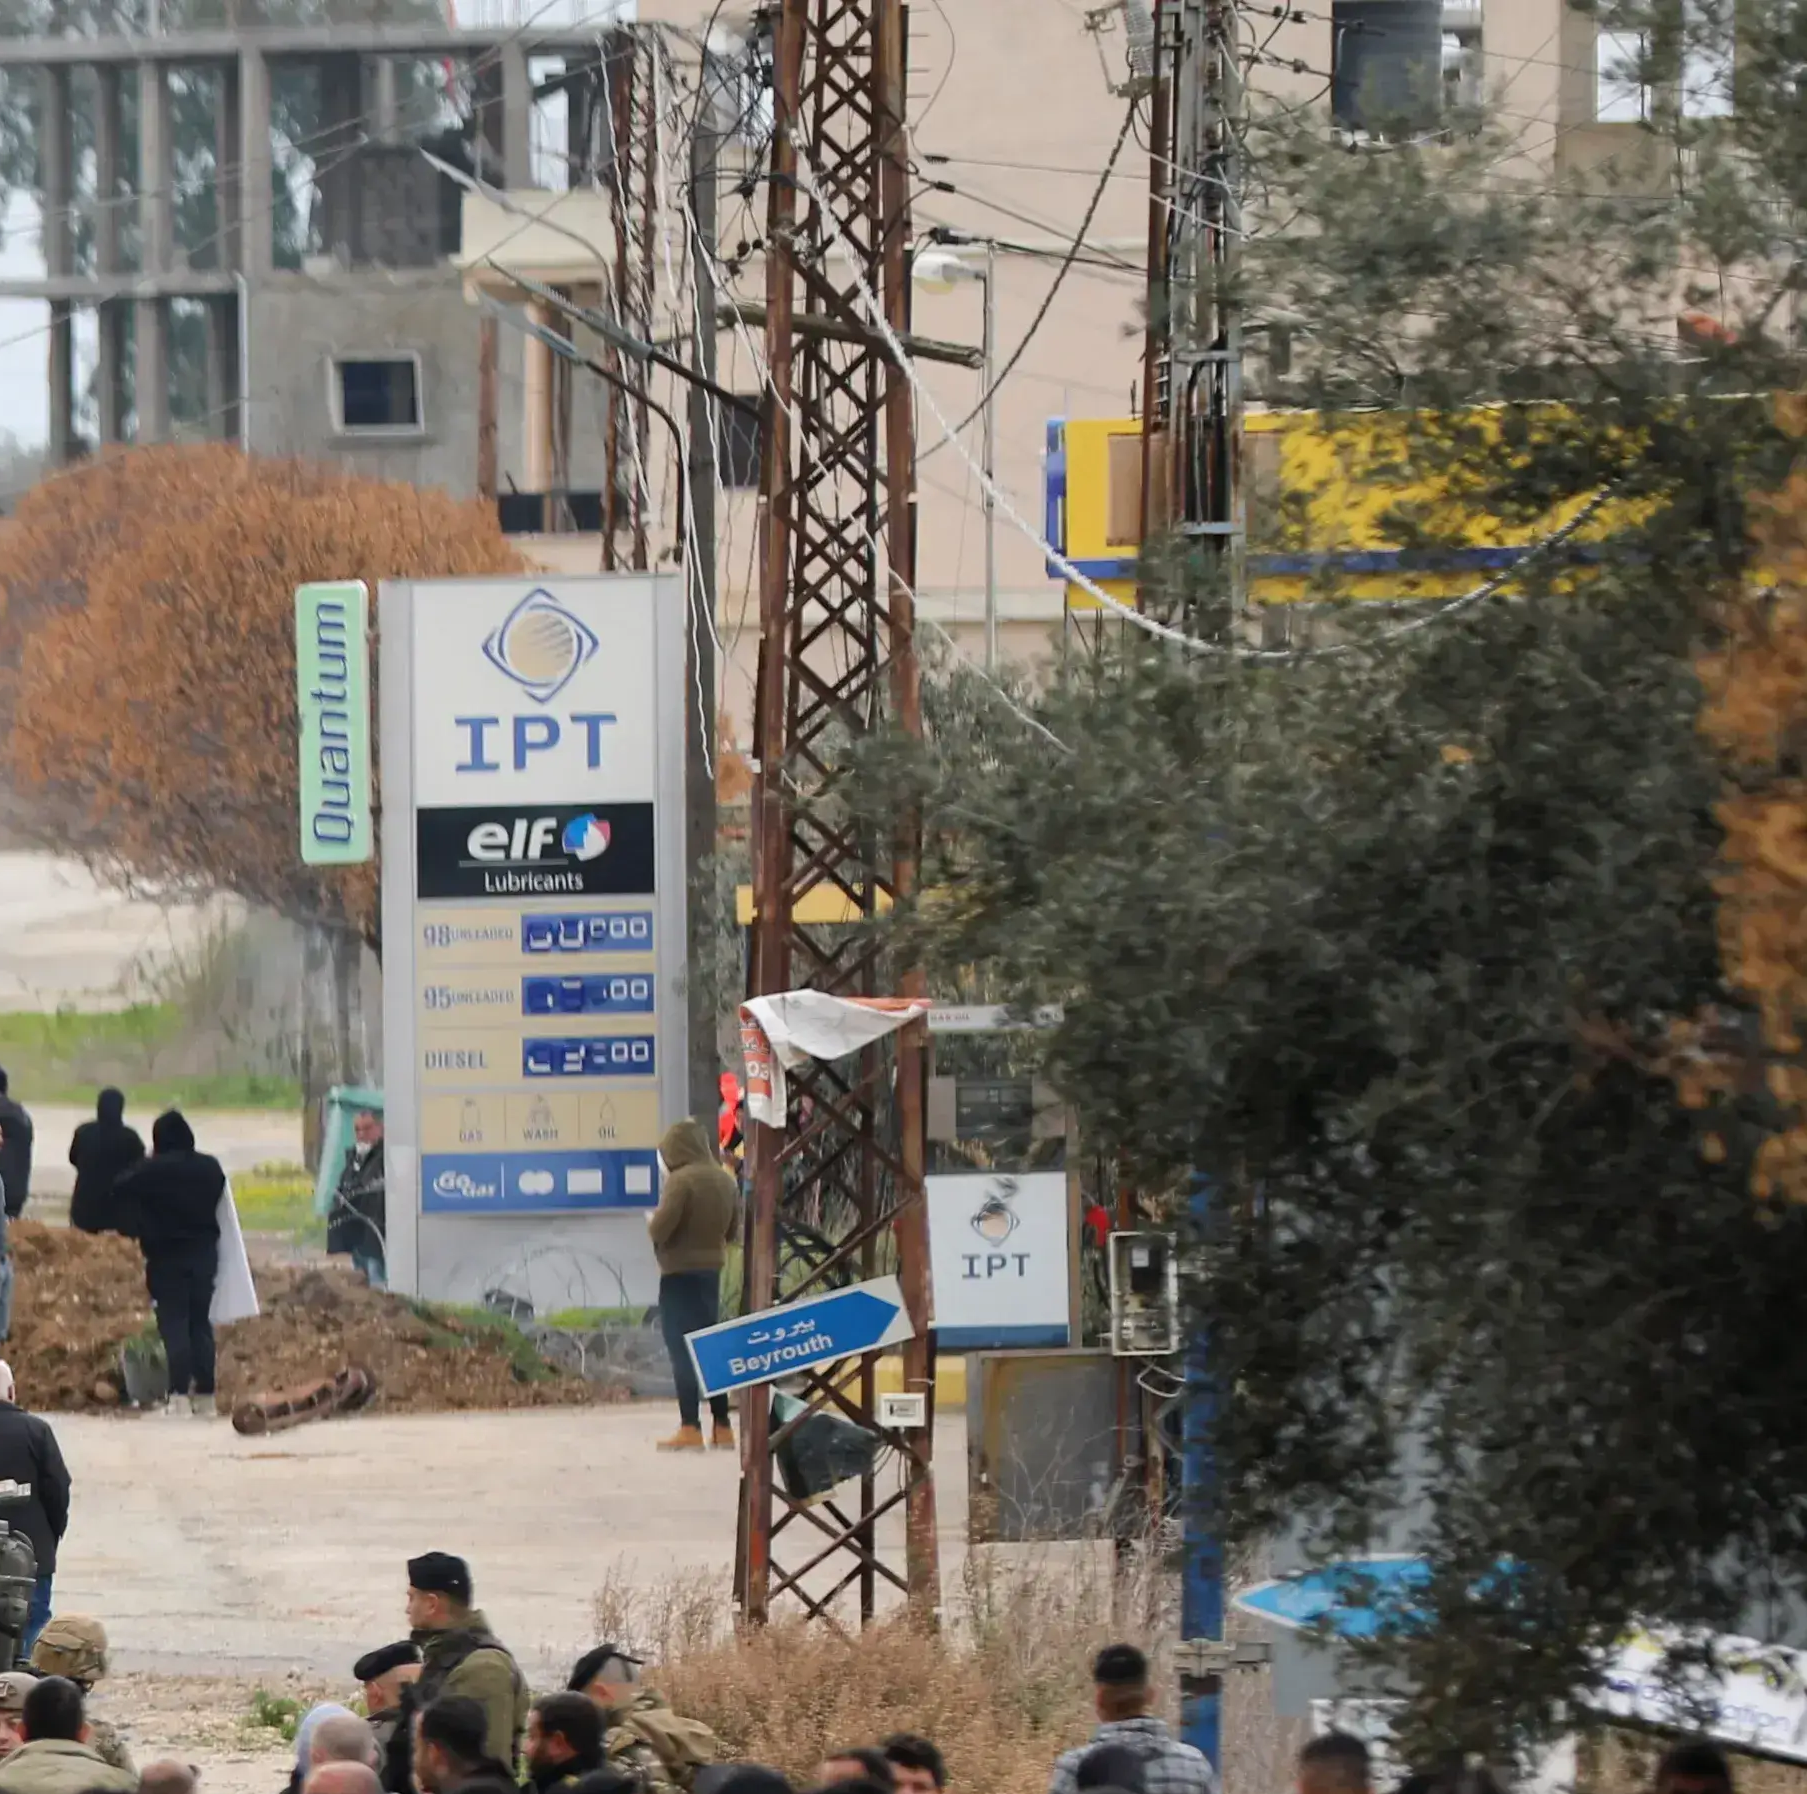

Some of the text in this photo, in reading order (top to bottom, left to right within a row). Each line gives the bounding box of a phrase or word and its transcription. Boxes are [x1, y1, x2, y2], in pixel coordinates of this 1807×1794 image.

[312, 602, 355, 846] Quantum
[454, 713, 618, 773] IPT
[467, 816, 558, 861] elf
[484, 870, 585, 893] Lubricants
[961, 1252, 1031, 1279] IPT
[747, 1318, 816, 1345] بيروت
[727, 1333, 834, 1376] Beyrouth
